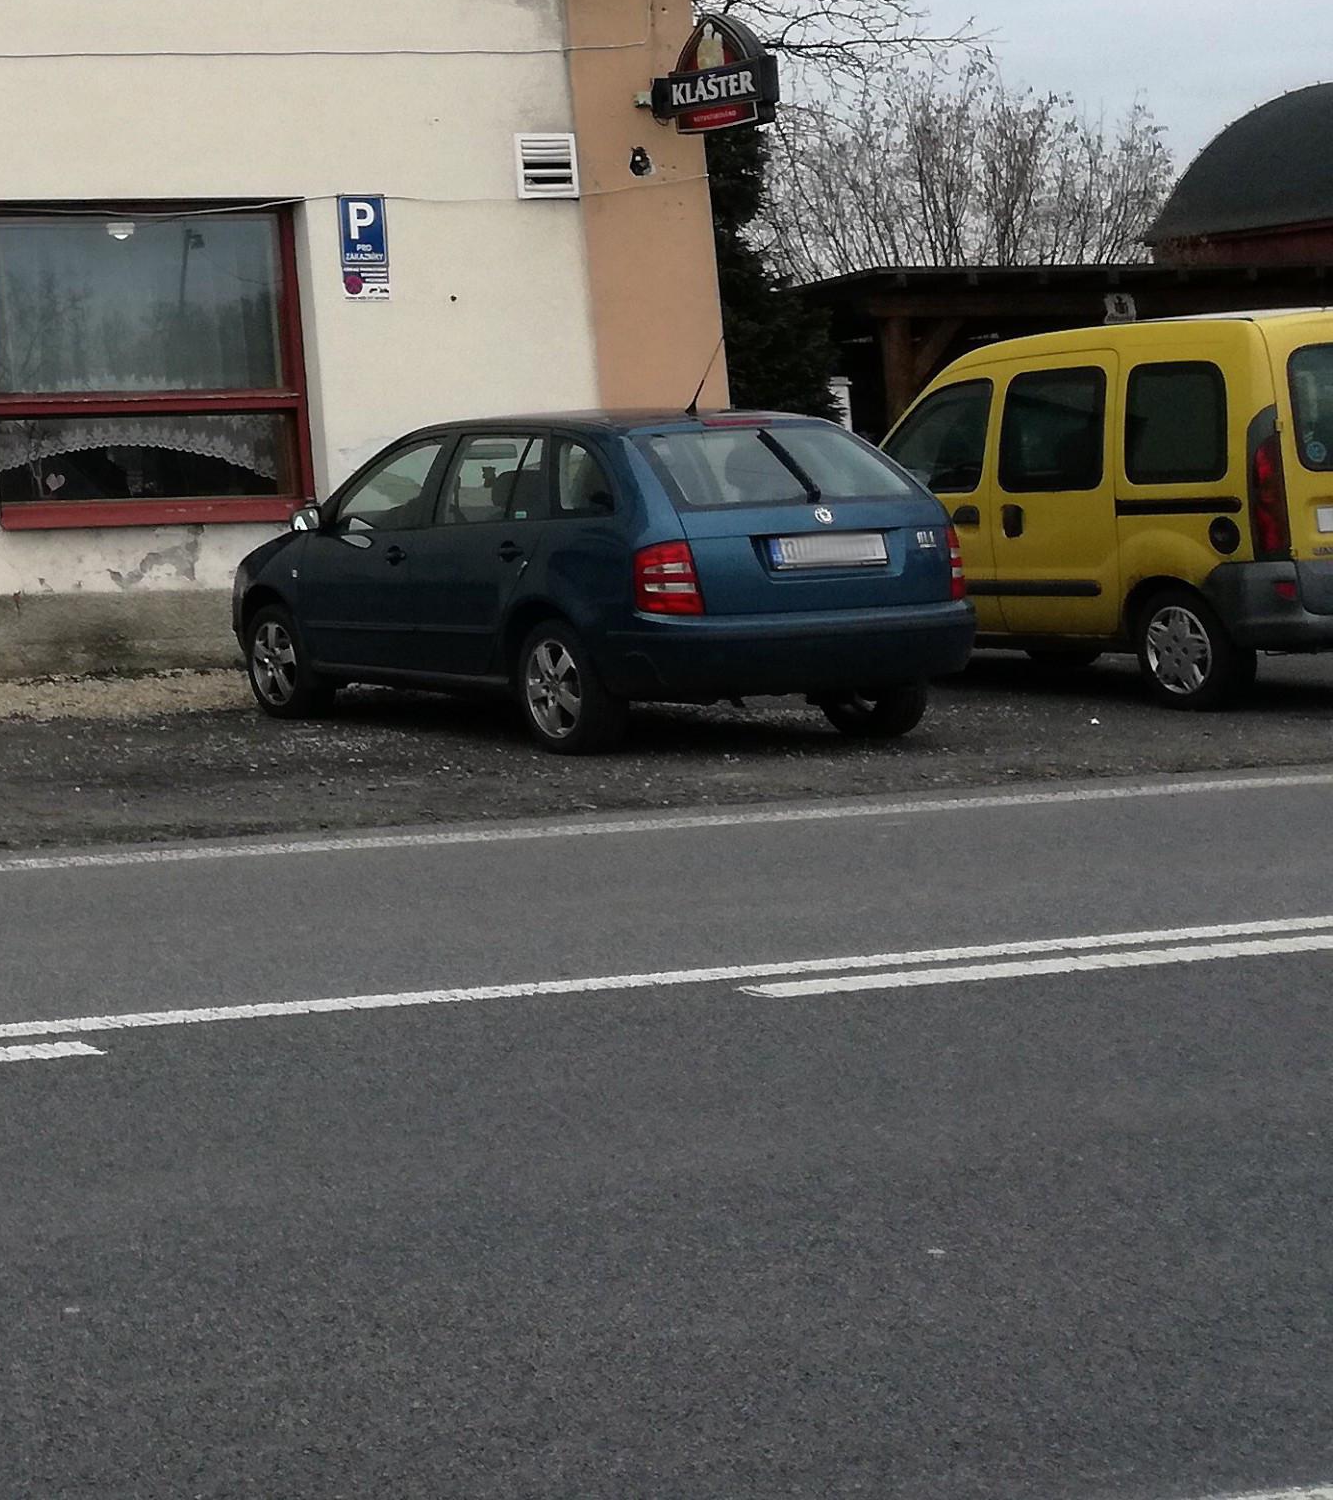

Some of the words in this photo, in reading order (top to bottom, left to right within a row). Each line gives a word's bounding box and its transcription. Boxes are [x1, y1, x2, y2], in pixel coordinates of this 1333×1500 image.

[671, 70, 757, 106] KLÁŠTER
[348, 202, 375, 240] P
[356, 243, 373, 252] PRO
